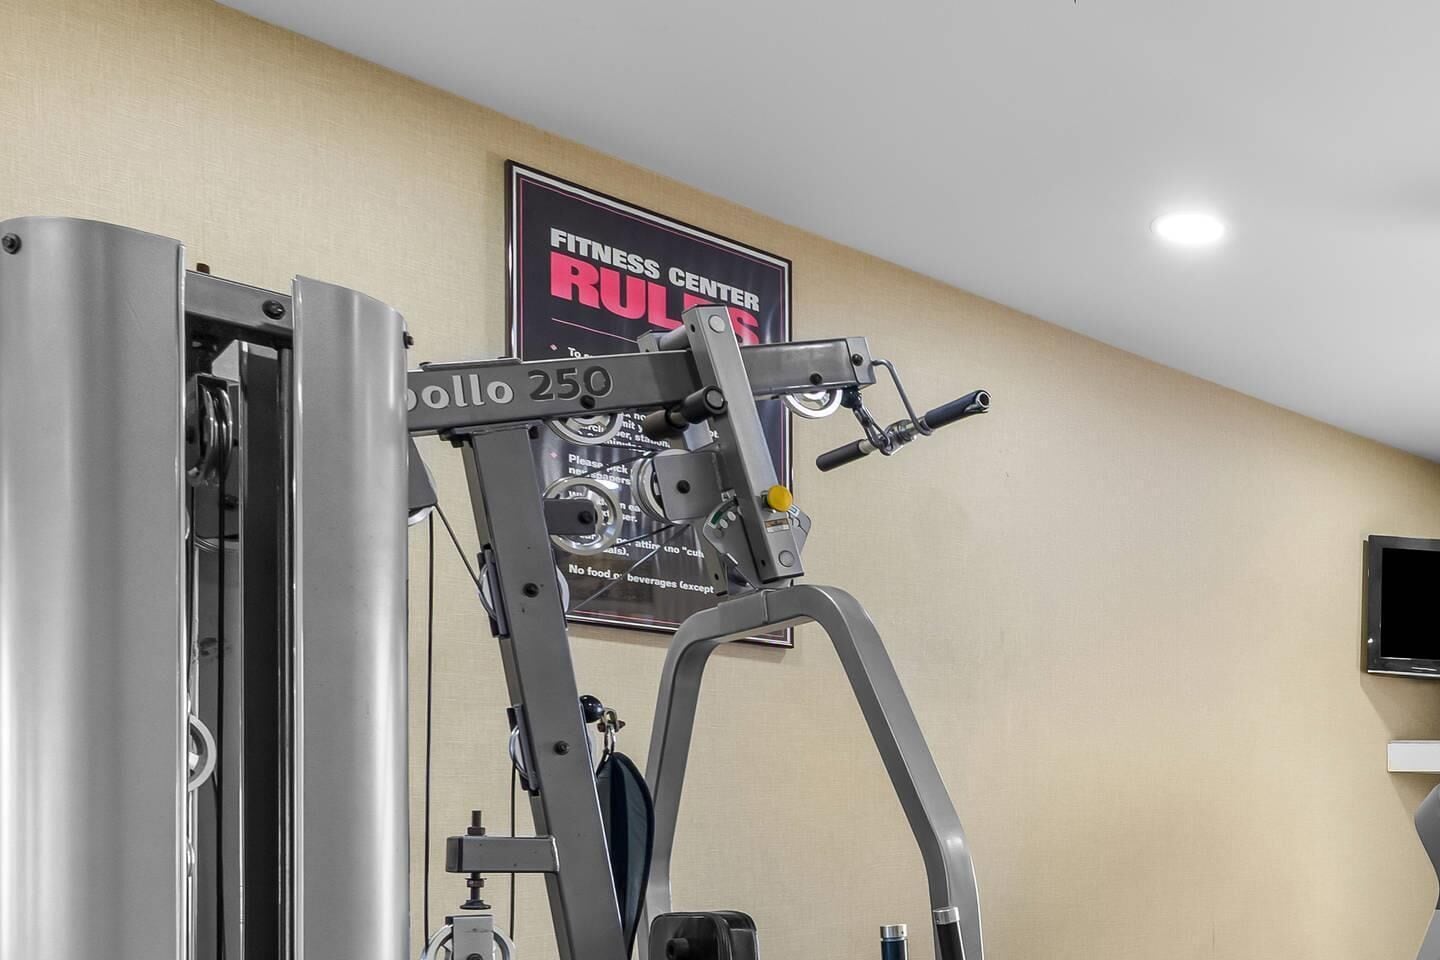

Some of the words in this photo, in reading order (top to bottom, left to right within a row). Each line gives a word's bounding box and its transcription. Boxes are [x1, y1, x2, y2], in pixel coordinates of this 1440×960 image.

[551, 228, 660, 279] FITNESS
[669, 267, 760, 312] CENTER
[551, 251, 760, 344] RULS
[407, 374, 514, 411] ollo
[528, 366, 613, 401] 250
[568, 453, 604, 468] Please
[568, 564, 586, 575] No
[587, 567, 611, 579] food
[627, 573, 677, 589] beverages
[679, 580, 715, 594] (except
